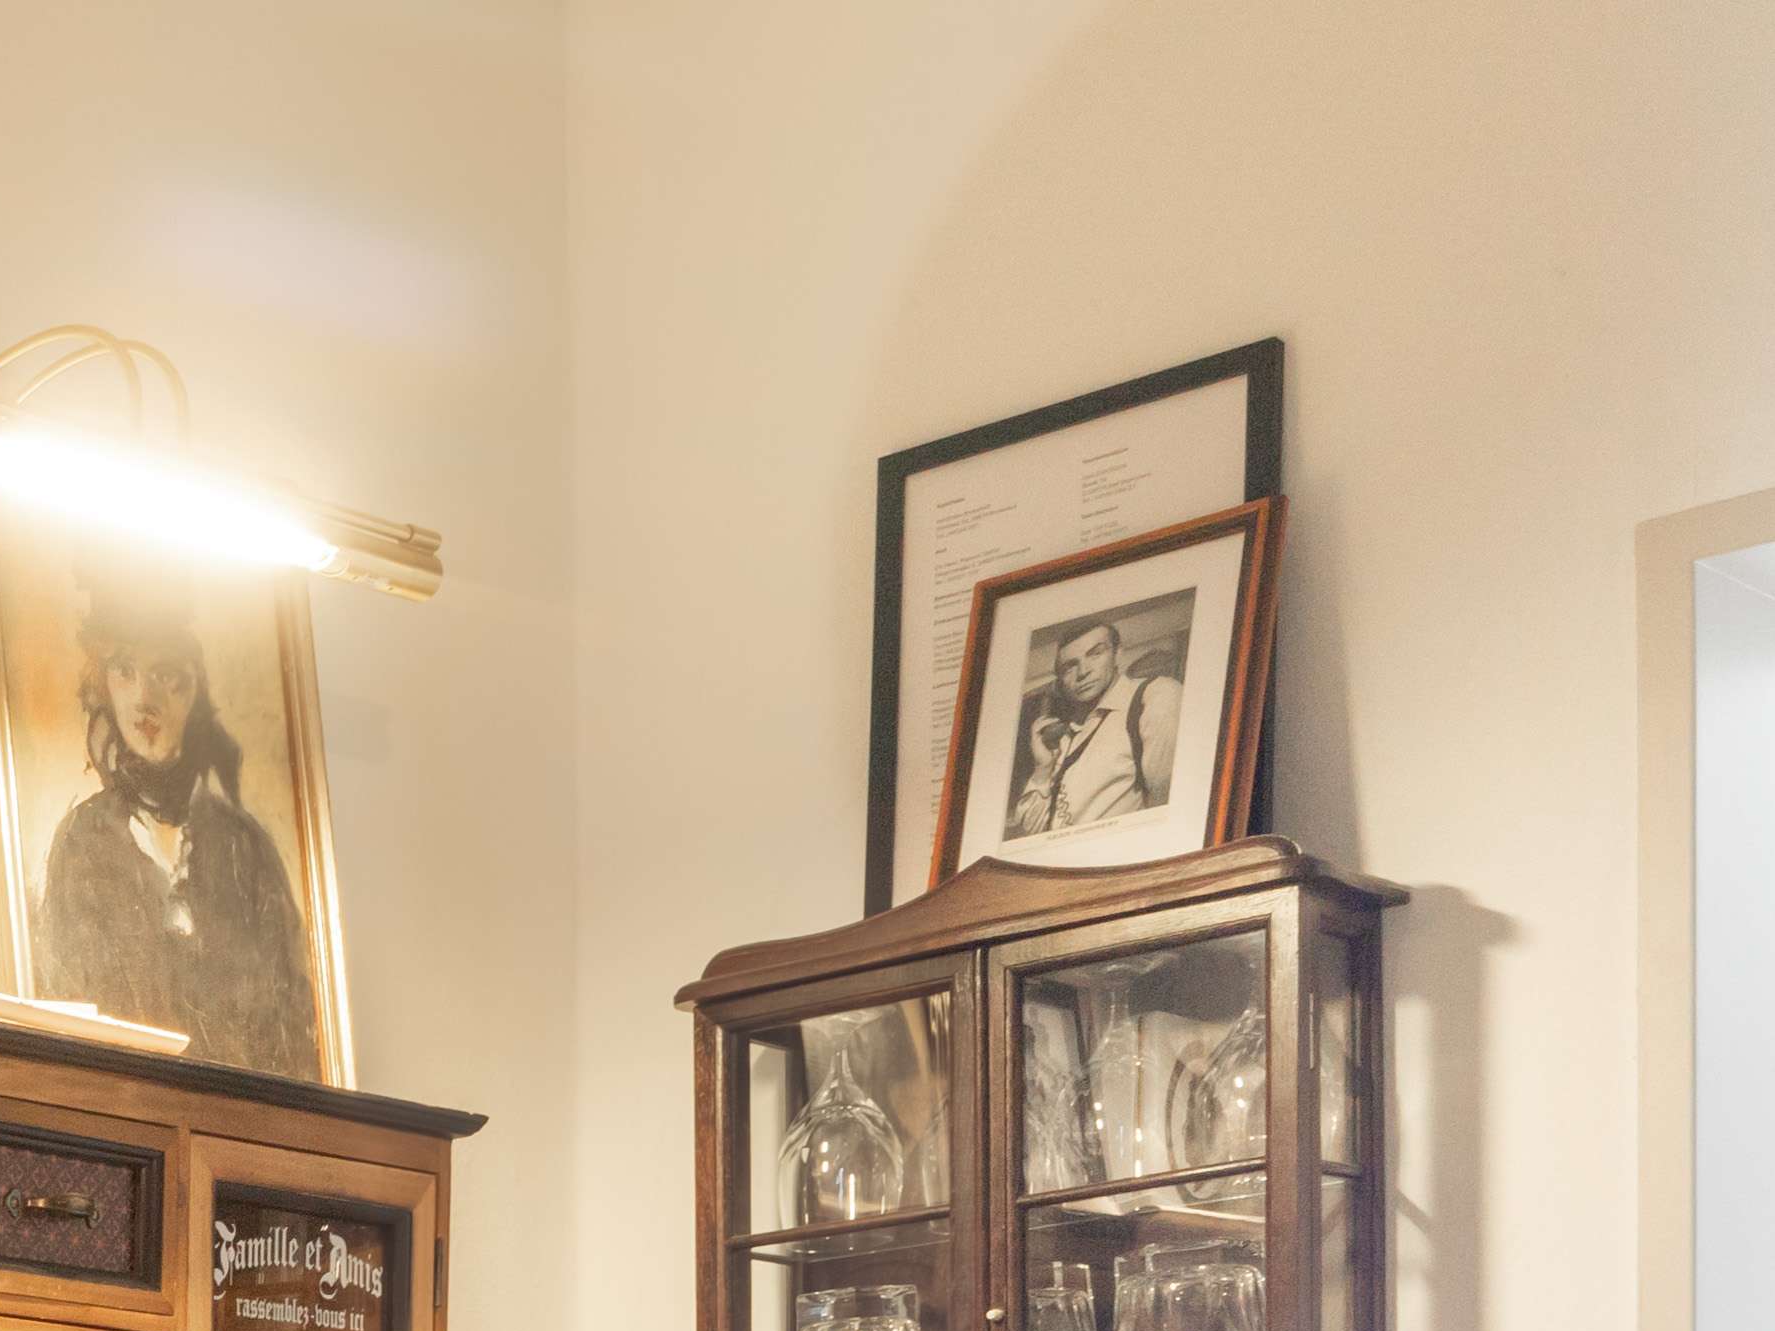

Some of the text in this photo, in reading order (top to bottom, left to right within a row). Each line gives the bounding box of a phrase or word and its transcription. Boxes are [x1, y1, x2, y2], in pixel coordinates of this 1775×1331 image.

[214, 1221, 383, 1300] Famille et Amis
[350, 1308, 364, 1331] ici
